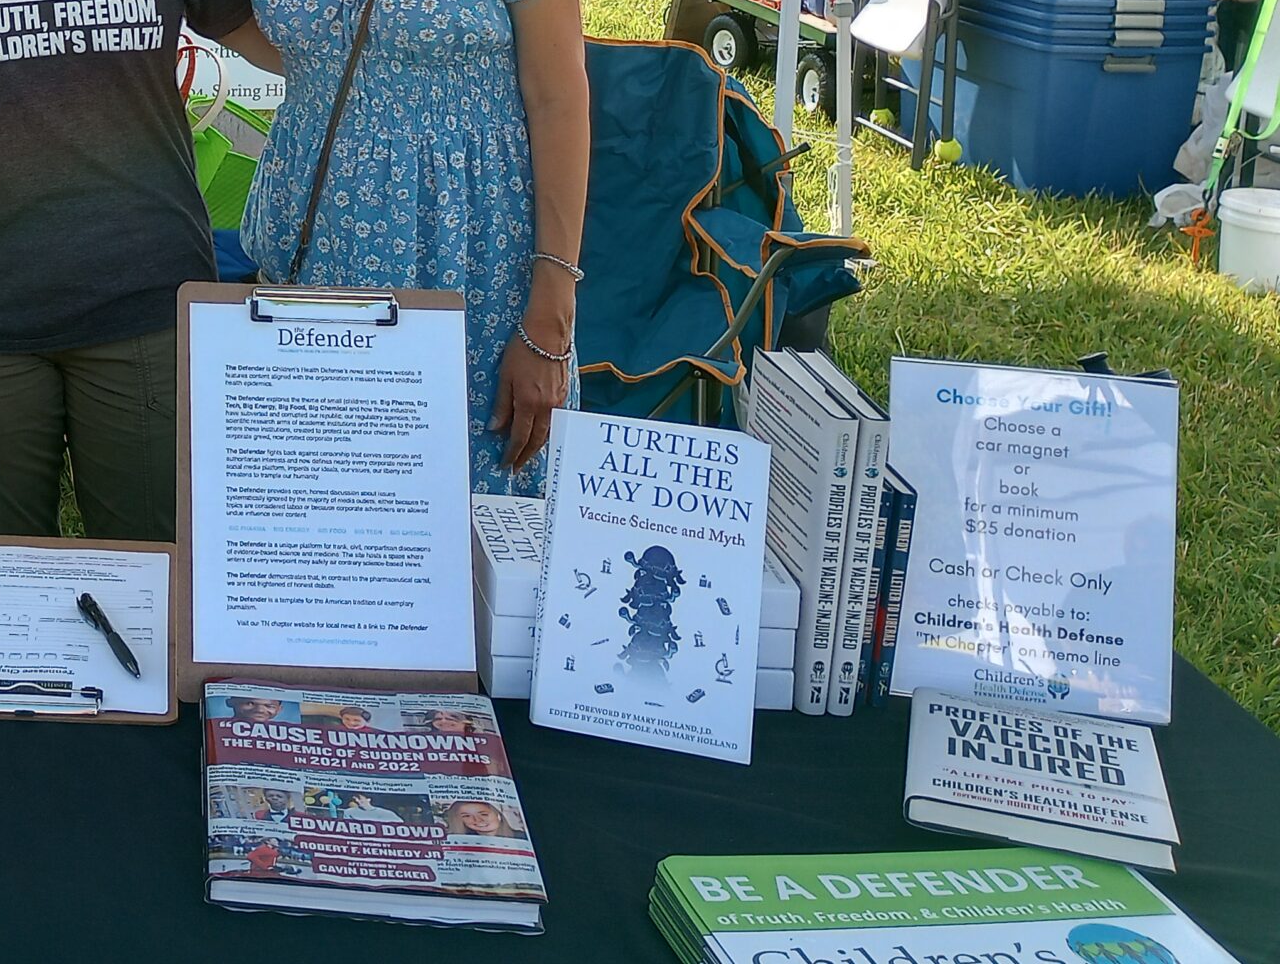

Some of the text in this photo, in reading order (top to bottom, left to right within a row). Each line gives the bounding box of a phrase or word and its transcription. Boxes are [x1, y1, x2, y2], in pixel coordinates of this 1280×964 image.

[92, 25, 164, 52] HEALTH
[212, 83, 261, 101] Sring
[265, 84, 283, 97] Hi
[278, 328, 374, 349] Defender
[936, 388, 1009, 409] Choose
[1069, 399, 1112, 418] Gift!
[984, 416, 1046, 436] Choose
[600, 421, 740, 466] TURTLES
[975, 439, 1070, 460] car magnet
[598, 450, 734, 492] ALL THE
[578, 473, 753, 523] WAY DOWN
[999, 479, 1039, 498] book
[578, 505, 746, 548] Vaccine Science and Myth
[1008, 504, 1079, 522] minimum
[474, 505, 515, 564] TURTLES
[965, 518, 1076, 543] $25 donation
[814, 484, 845, 649] PROFILES VACCINE-INJURED
[929, 557, 1112, 595] Cash Check Only
[948, 596, 1065, 619] checks payable
[914, 612, 1124, 646] Children's Health Defense
[916, 631, 1121, 667] "TN Chapter" memo line
[974, 668, 1044, 687] Children's
[974, 682, 1047, 698] Health Defense
[549, 708, 650, 733] EDITED ZOEY O'TOOLE
[574, 703, 699, 733] FOREWORD MARY HOLLAND,
[929, 703, 1043, 734] PROFILES
[1092, 732, 1140, 752] THE
[222, 738, 491, 765] THE EPIDEMIC SUDDEN DEATHS
[950, 718, 1121, 767] VACCINE
[310, 756, 420, 772] 2021 2022
[947, 737, 1125, 787] INJURED
[963, 770, 1025, 787] LIFETIME
[1031, 782, 1075, 796] PRICE
[932, 777, 1149, 825] CHILDREN'S HEALTH DEFENSE
[1006, 800, 1046, 813] ROBERT
[289, 817, 377, 835] EDWARD
[382, 825, 445, 838] DOWD
[300, 841, 441, 859] ROBERT KENNEDY JR
[319, 864, 429, 880] GAVIN BECKER
[688, 864, 1100, 903] BE DEFENDER
[742, 898, 1127, 927] Truth, Freedom, Children's Health
